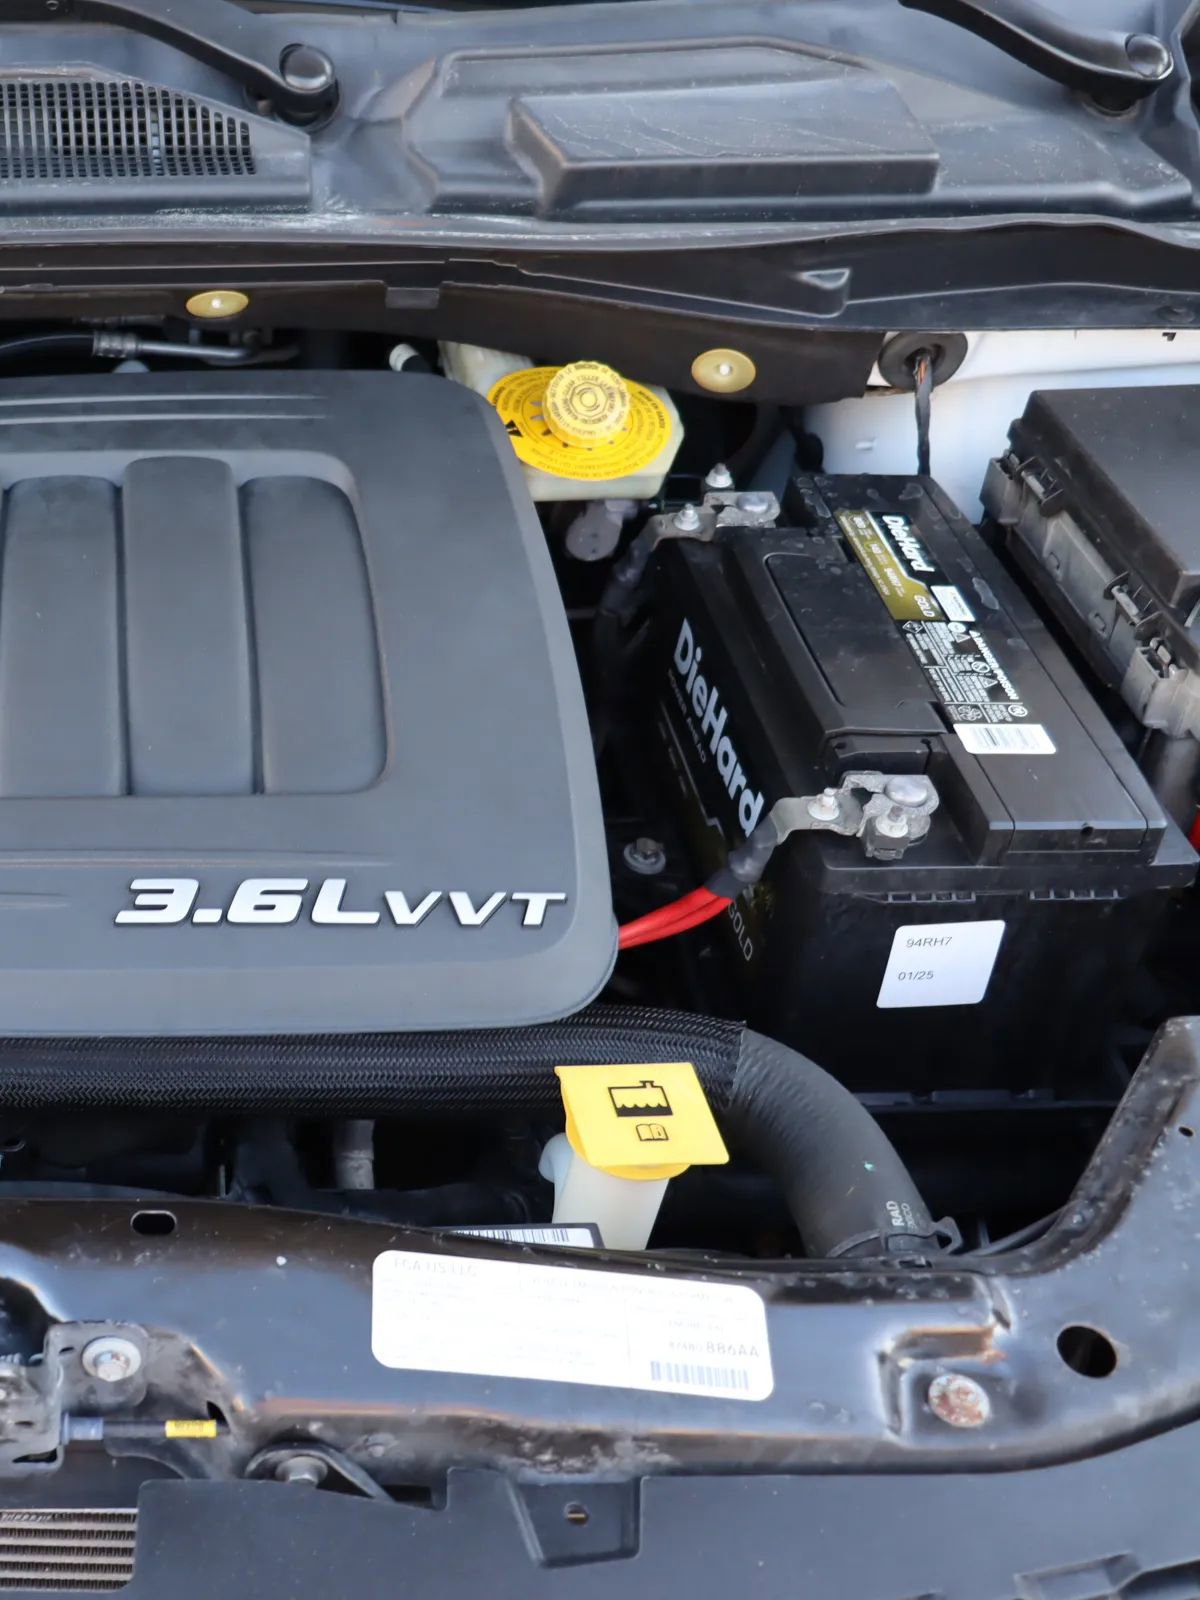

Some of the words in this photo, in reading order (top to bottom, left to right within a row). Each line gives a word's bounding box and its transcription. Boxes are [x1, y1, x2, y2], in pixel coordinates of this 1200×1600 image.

[882, 515, 935, 572] DieHard
[914, 594, 935, 617] GOLD
[673, 617, 765, 838] DieHard
[384, 890, 567, 926] VVT
[728, 902, 753, 961] GOLD
[905, 936, 953, 948] 94RH7
[897, 970, 934, 981] 01/25
[885, 1200, 905, 1227] RAD
